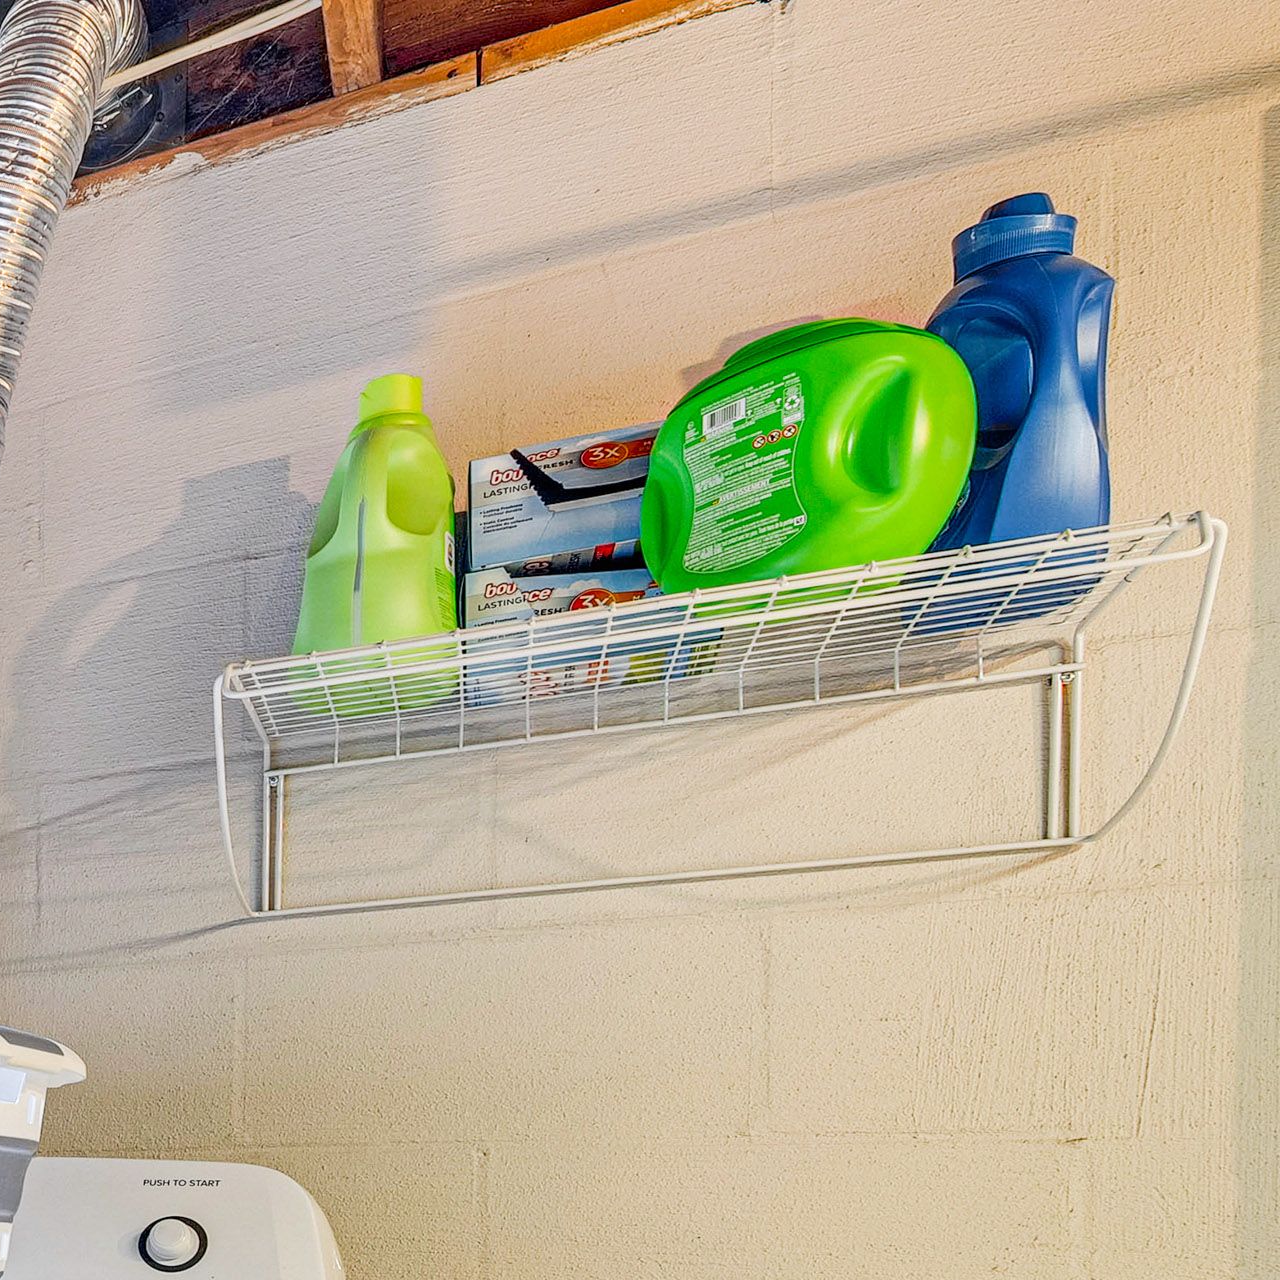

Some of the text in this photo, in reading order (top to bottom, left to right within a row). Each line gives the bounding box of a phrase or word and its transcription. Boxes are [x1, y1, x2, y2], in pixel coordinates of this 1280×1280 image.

[143, 1179, 221, 1187] PUSH TO START
